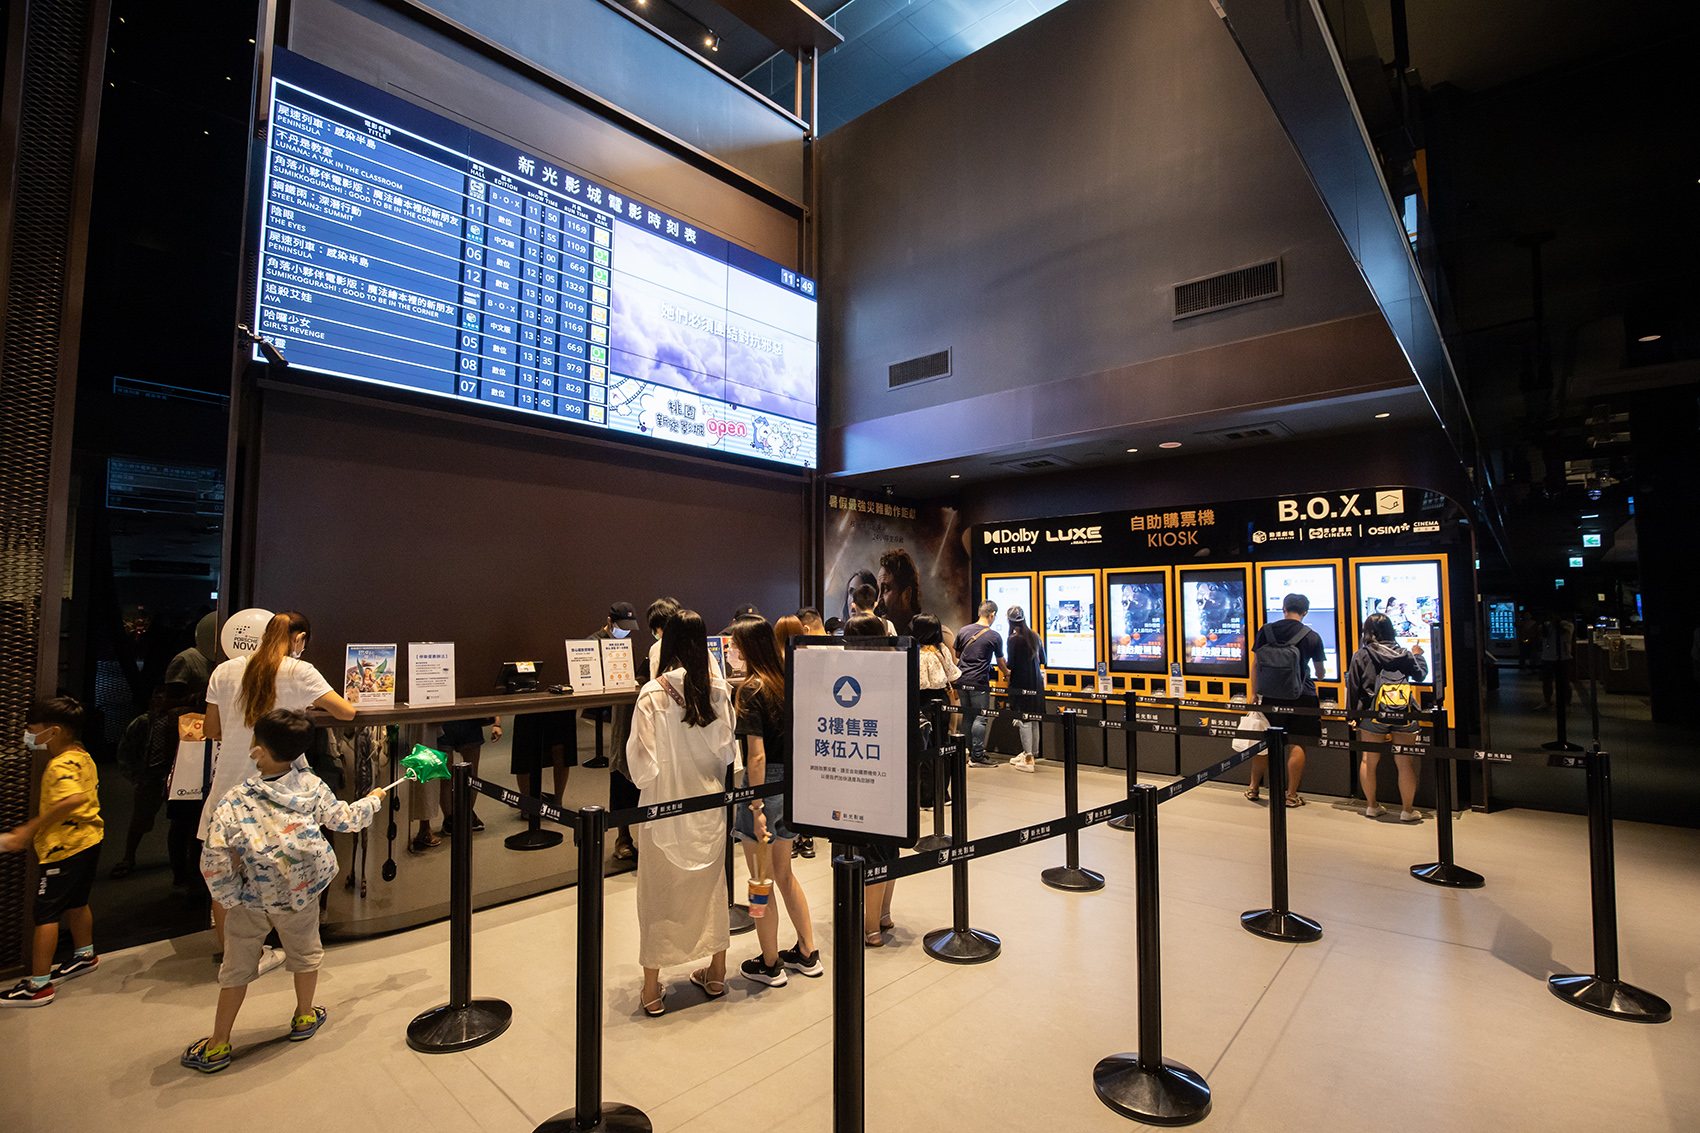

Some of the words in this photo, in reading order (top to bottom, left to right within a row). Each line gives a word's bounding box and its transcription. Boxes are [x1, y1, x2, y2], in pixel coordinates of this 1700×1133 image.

[277, 115, 321, 136] PENINSULA
[368, 128, 387, 140] TITLE
[276, 130, 333, 158] 不丹是教室
[275, 139, 310, 157] LUNANA:
[319, 155, 334, 166] YAK
[335, 161, 344, 169] IN
[345, 164, 359, 175] THE
[360, 170, 403, 190] CLASSROOM
[470, 169, 486, 179] HALL
[494, 178, 518, 191] EDITION
[273, 165, 343, 194] SUMIKKOGURASHI
[349, 190, 371, 204] GOOD
[372, 197, 382, 207] TO
[383, 200, 393, 211] BE
[394, 203, 401, 213] IN
[402, 206, 416, 218] THE
[417, 211, 444, 228] CORNER
[518, 155, 697, 245] 新光影城電影時刻表
[527, 191, 544, 202] SHOW
[545, 199, 558, 208] TIME
[271, 190, 296, 204] STEEL
[296, 197, 322, 213] RAIN2:
[323, 204, 354, 222] SUMMIT
[271, 205, 295, 221] 陰眼
[469, 204, 482, 217] 11
[564, 205, 576, 214] RUN
[577, 209, 589, 220] TIME
[270, 216, 286, 227] THE
[288, 221, 307, 232] EYES
[567, 220, 587, 235] 116分
[268, 242, 313, 259] PENINSULA
[466, 247, 482, 261] 06
[567, 240, 587, 254] 110分
[569, 262, 586, 274] 66分
[466, 269, 481, 283] 12
[265, 282, 313, 304] 追殺艾娃
[266, 268, 337, 291] SUMIKKOGURASHI
[343, 288, 365, 299] GOOD
[367, 293, 377, 302] TO
[378, 295, 387, 304] BE
[389, 298, 396, 306] IN
[397, 299, 411, 311] THE
[412, 304, 439, 318] CORNER
[565, 281, 585, 294] 132分
[264, 294, 281, 304] AVA
[564, 301, 585, 314] 101分
[264, 309, 311, 329] 哈囉少女
[289, 324, 325, 340] REVENGE
[564, 321, 584, 333] 116分
[661, 302, 783, 356] 她們必須團結對抗邪惡
[462, 335, 478, 349] 05
[567, 342, 583, 354] 66分
[461, 357, 477, 371] 08
[566, 363, 583, 374] 97分
[460, 380, 476, 393] 07
[566, 383, 582, 394] 82分
[565, 403, 581, 414] 90分
[667, 399, 696, 421] 桃園
[708, 419, 746, 437] open
[1278, 494, 1372, 522] B.O.X.
[1130, 510, 1215, 531] 自助購票機
[1001, 527, 1039, 544] Dolby
[1045, 526, 1102, 542] LUXE
[1324, 531, 1353, 539] CINEMA
[1367, 525, 1401, 536] OSIM
[1147, 530, 1199, 547] KIOSK
[993, 545, 1032, 555] CINEMA
[232, 641, 258, 651] NOW
[817, 716, 879, 738] 3樓售票
[814, 738, 880, 761] 隊伍入口
[865, 865, 887, 877] 光影城
